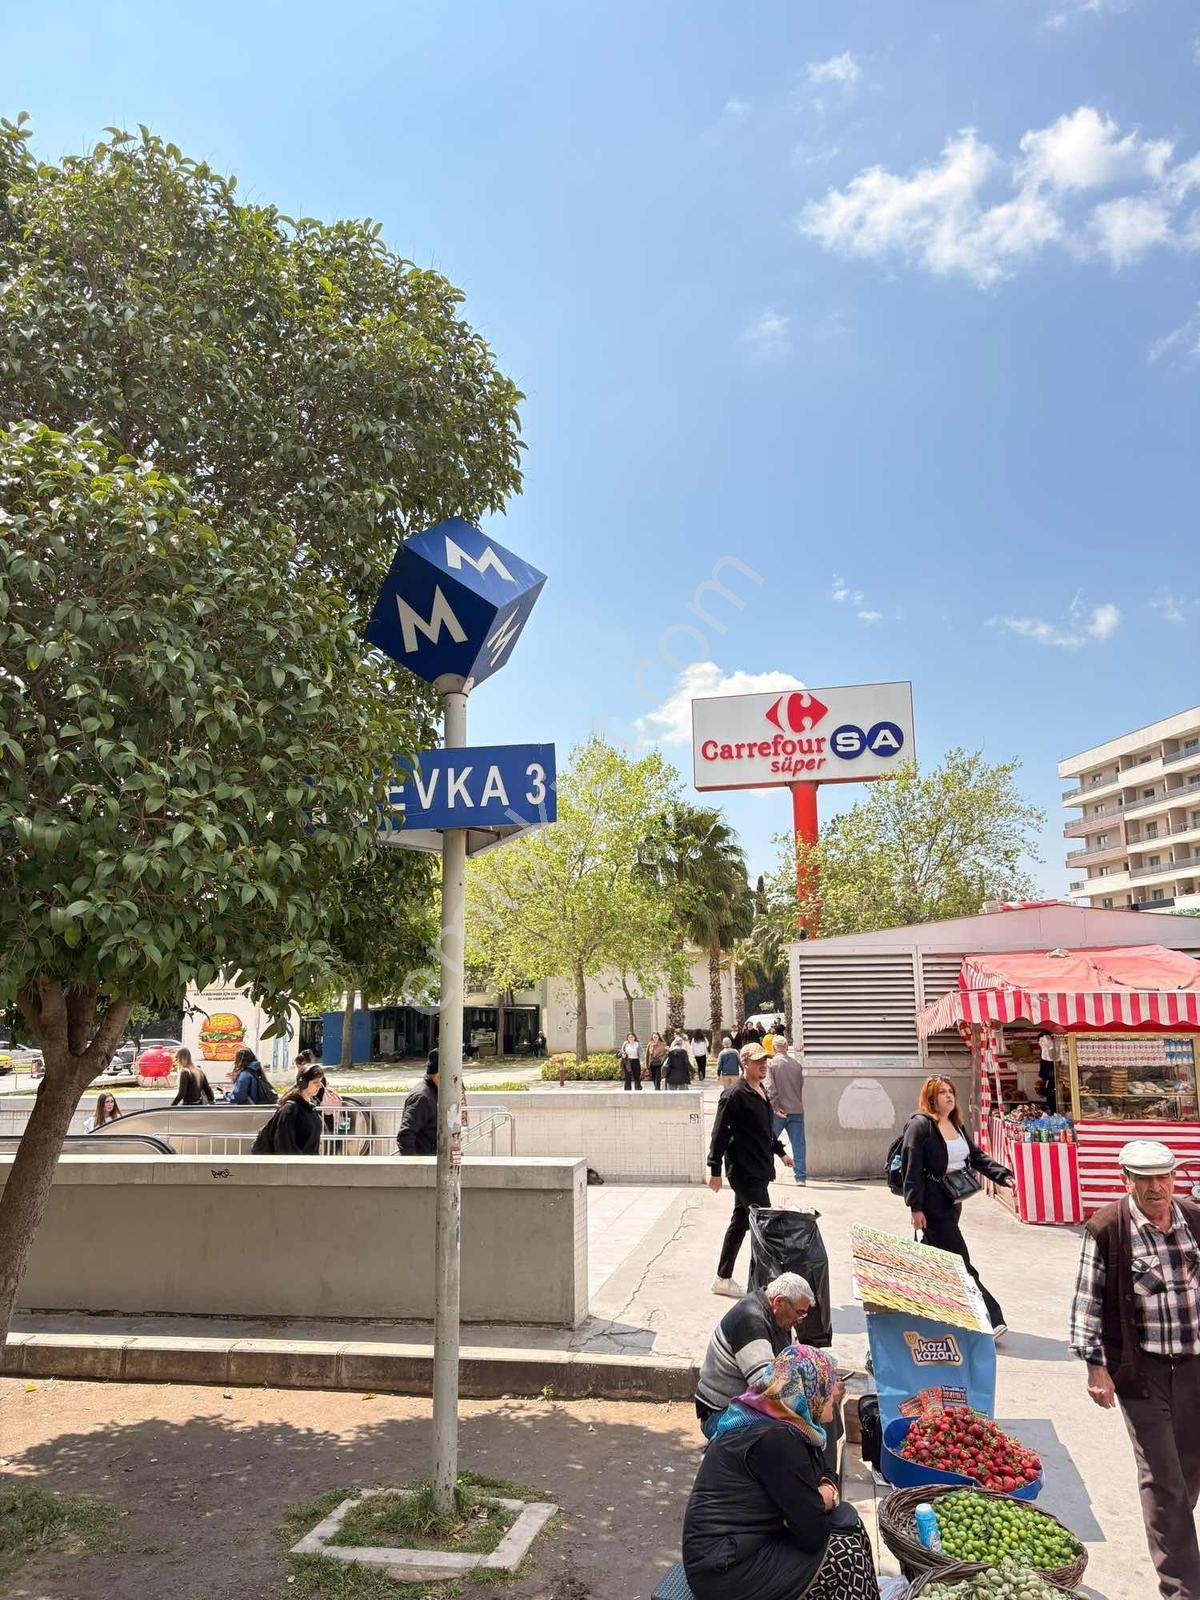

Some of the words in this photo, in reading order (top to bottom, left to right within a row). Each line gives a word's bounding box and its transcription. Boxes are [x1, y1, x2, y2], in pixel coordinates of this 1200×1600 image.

[445, 535, 517, 584] M
[396, 584, 469, 654] M
[701, 734, 827, 762] Carrefour
[771, 757, 827, 778] süper
[525, 762, 547, 806] 3
